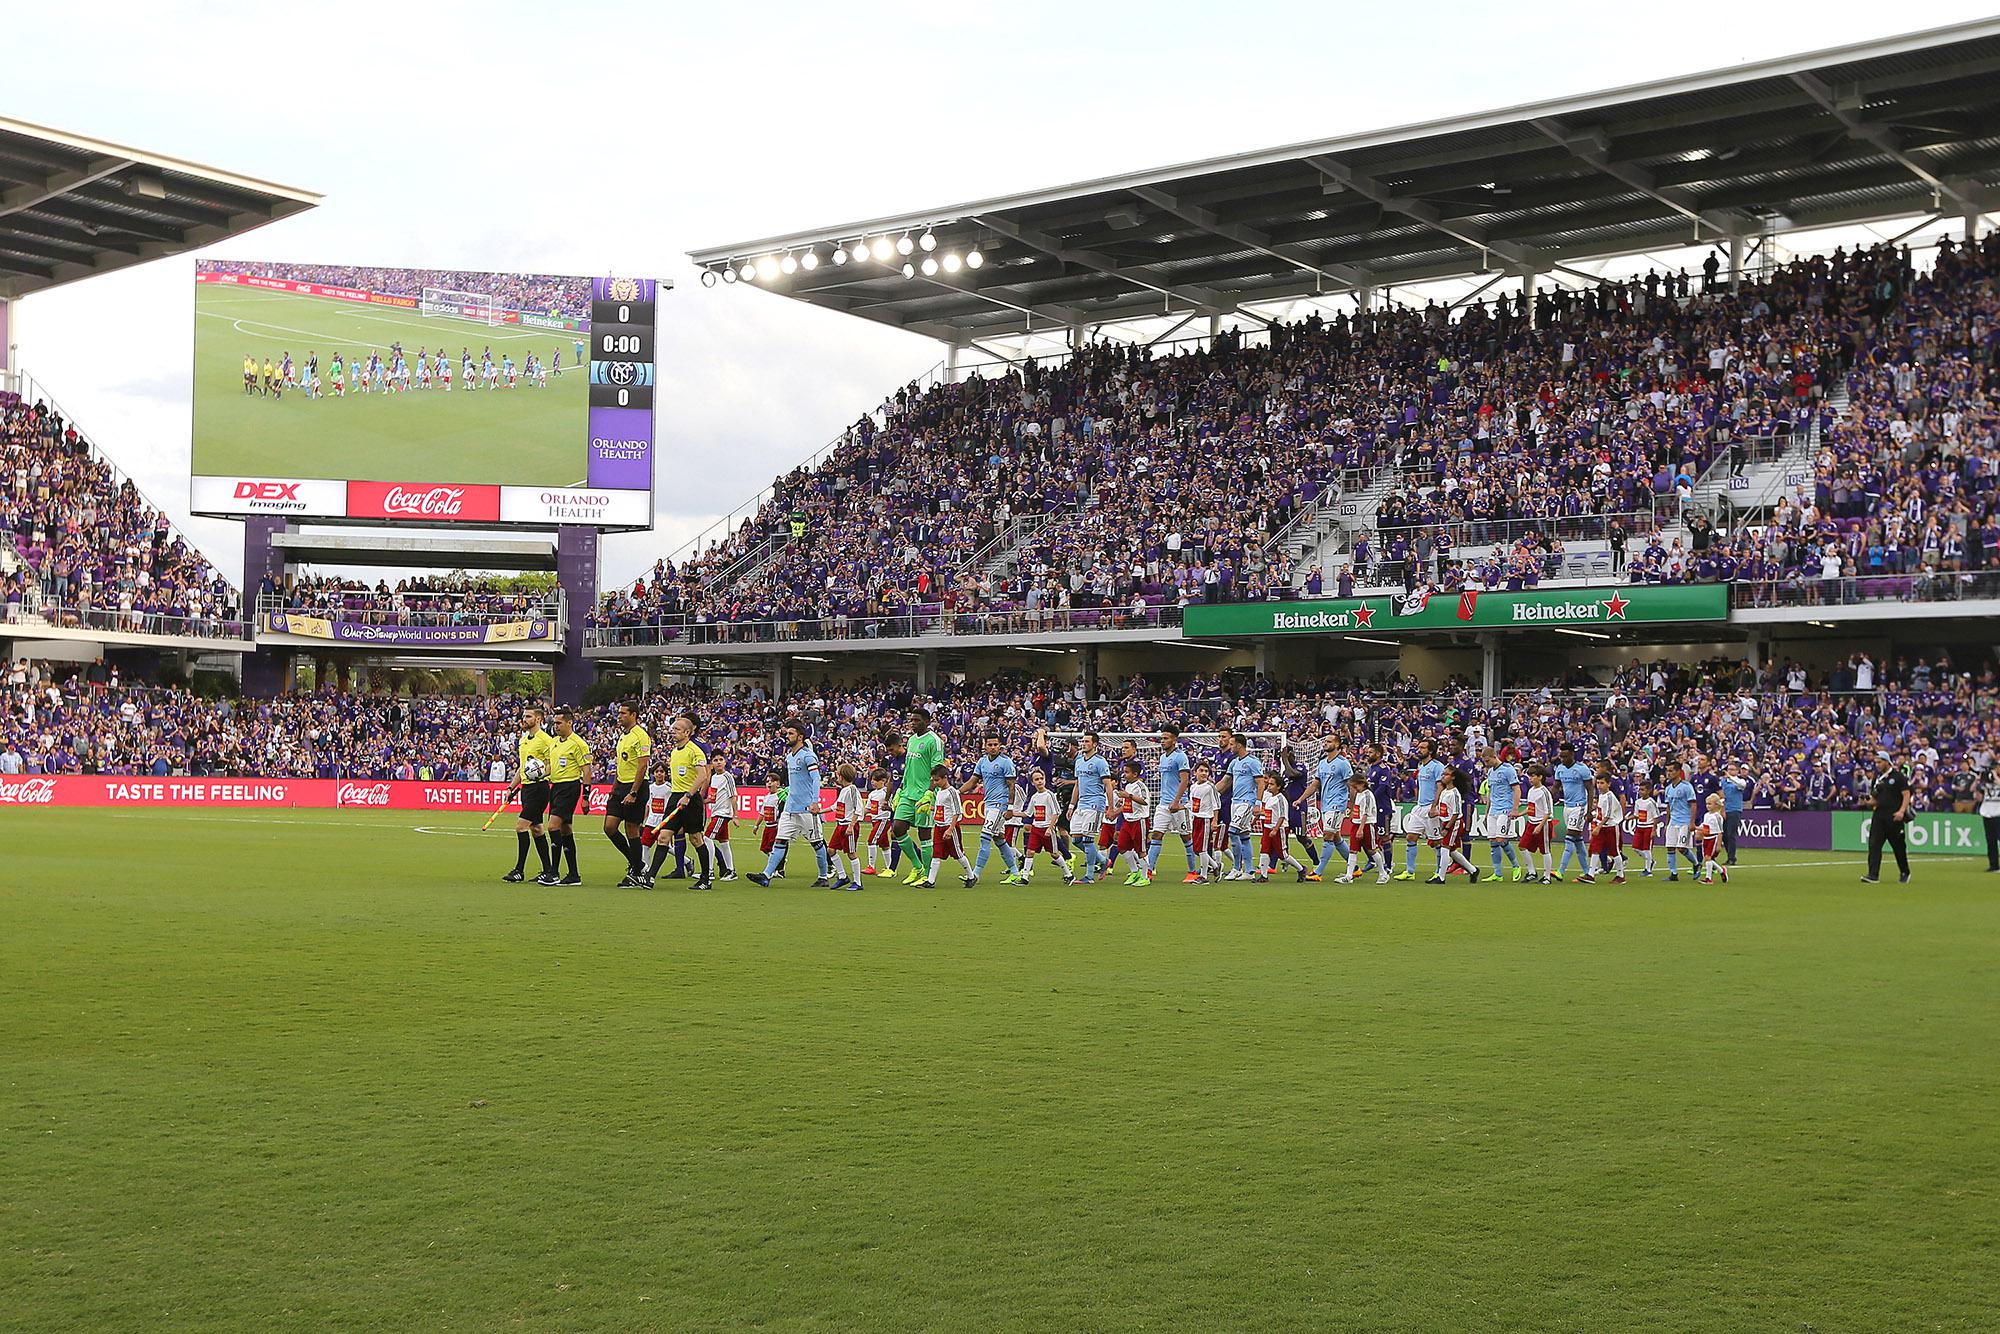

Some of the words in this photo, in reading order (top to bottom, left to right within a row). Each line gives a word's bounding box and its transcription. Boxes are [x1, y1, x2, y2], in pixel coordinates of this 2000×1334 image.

[522, 314, 564, 329] Heineken
[618, 305, 630, 323] 0
[603, 335, 640, 353] 0:00
[618, 388, 629, 406] 0
[593, 438, 648, 450] ORLANDO
[599, 449, 643, 460] HEALTH
[233, 482, 302, 500] DEX
[1730, 479, 1748, 489] 104
[249, 500, 307, 510] imaging
[384, 486, 465, 515] Coca-Cola
[540, 492, 610, 506] ORLANDO
[549, 506, 603, 519] HEALTH
[1341, 505, 1357, 515] 103
[1273, 609, 1349, 629] Heineken
[1512, 600, 1600, 621] Heineken
[398, 630, 422, 640] World
[425, 631, 457, 640] LION'S
[459, 631, 479, 639] DEN
[106, 783, 165, 800] TASTE
[170, 784, 205, 801] THE
[211, 785, 285, 801] FEELING
[338, 783, 392, 805] Coca-Cola
[424, 788, 463, 805] TASTE
[465, 789, 490, 804] THE
[1737, 819, 1784, 838] World
[1860, 817, 1973, 847] Pblix
